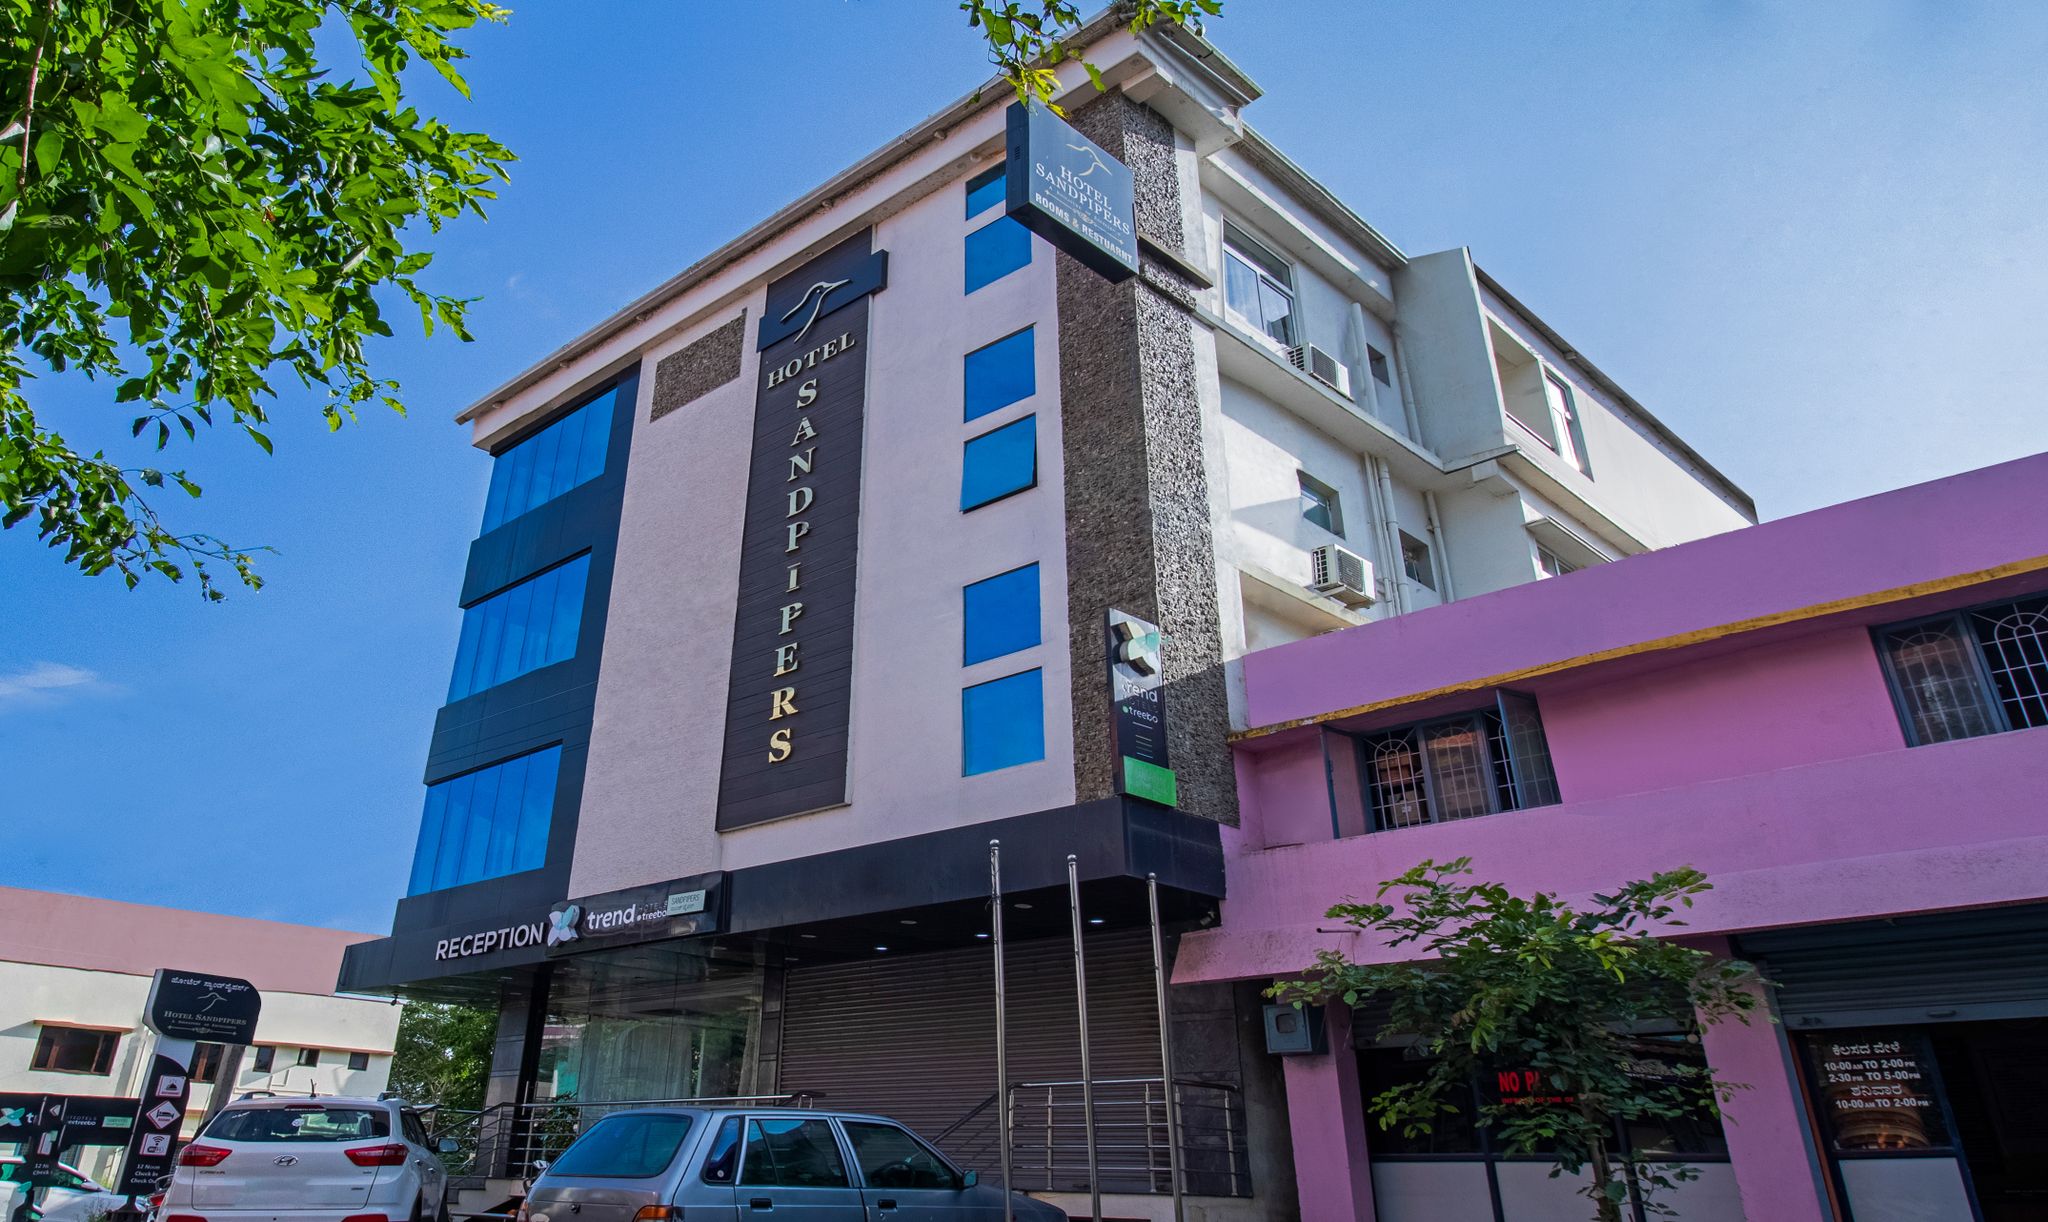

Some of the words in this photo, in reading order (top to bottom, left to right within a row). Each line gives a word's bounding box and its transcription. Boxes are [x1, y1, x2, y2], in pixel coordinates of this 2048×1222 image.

[1061, 165, 1112, 211] HOTEL
[1036, 163, 1130, 235] SANDPIPERS
[1035, 193, 1070, 222] ROOMS
[1072, 218, 1079, 228] &
[1082, 224, 1133, 263] RESTUARNT
[767, 332, 856, 390] HOTEL
[768, 378, 818, 764] SANDPIPERS
[1128, 706, 1159, 723] treebo
[642, 910, 667, 921] treebo
[435, 922, 545, 960] RECEPTION
[587, 903, 637, 930] trend
[164, 1010, 194, 1020] HOTEL
[195, 1013, 247, 1026] SANDPIPERS
[1832, 1043, 1871, 1056] ಕೆಲಸದ
[1863, 1060, 1878, 1069] TO
[1498, 1071, 1520, 1094] NO
[1865, 1072, 1881, 1081] TO
[1850, 1083, 1903, 1096] ಶನಿವಾರ
[1875, 1098, 1890, 1107] TO
